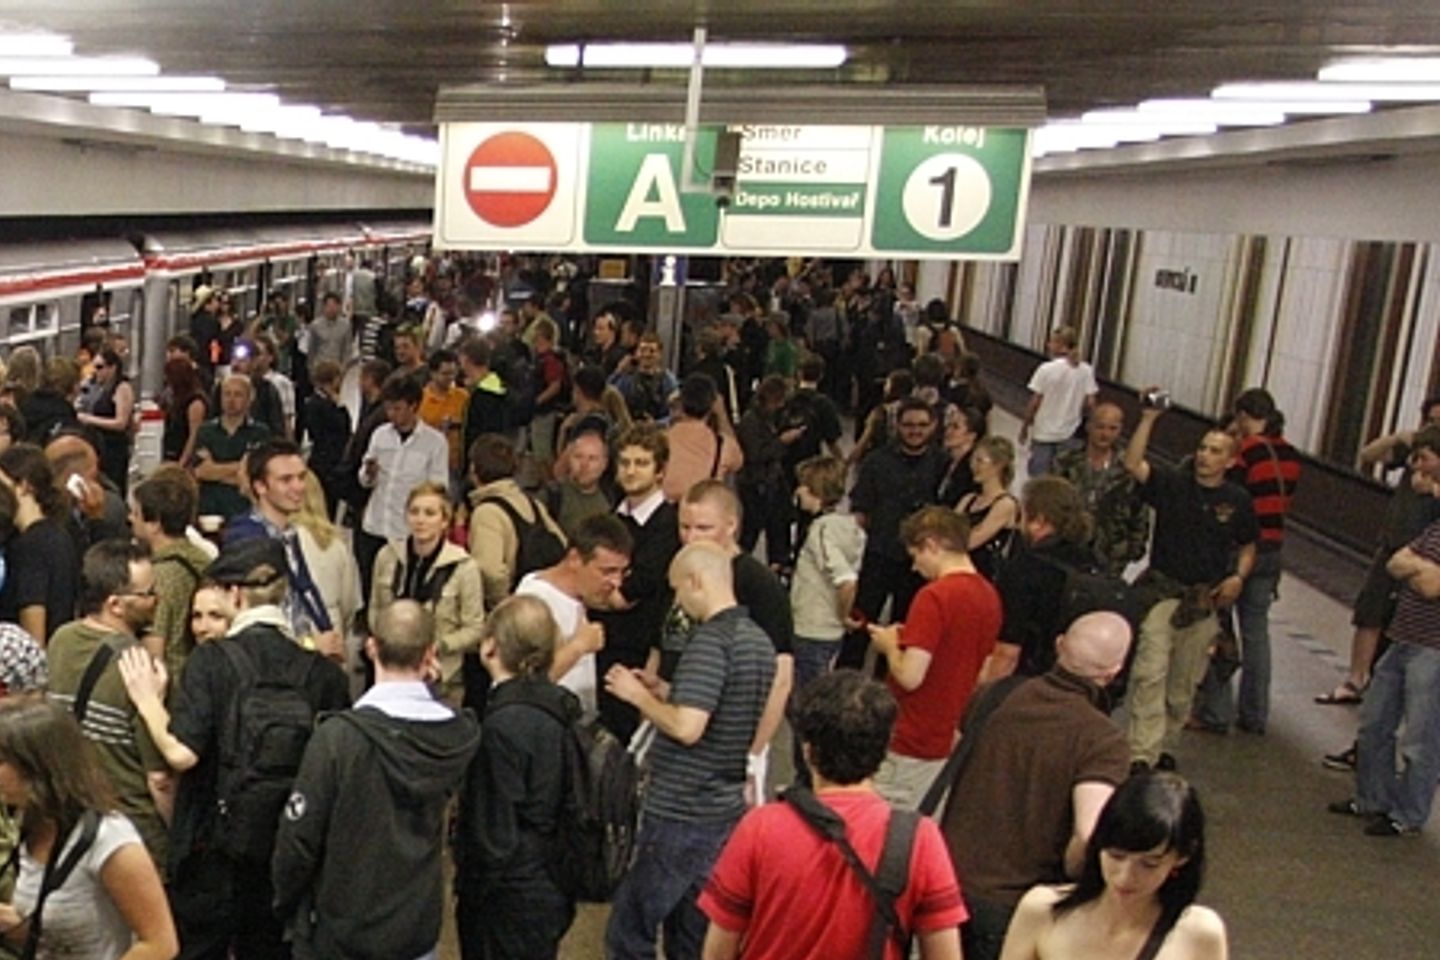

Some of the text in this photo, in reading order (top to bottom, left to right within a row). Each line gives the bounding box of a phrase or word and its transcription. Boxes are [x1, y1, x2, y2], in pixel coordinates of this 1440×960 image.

[923, 124, 985, 149] Kolej
[739, 156, 827, 174] Stanice
[613, 152, 687, 232] A
[735, 192, 780, 209] Depo
[928, 166, 958, 228] 1
